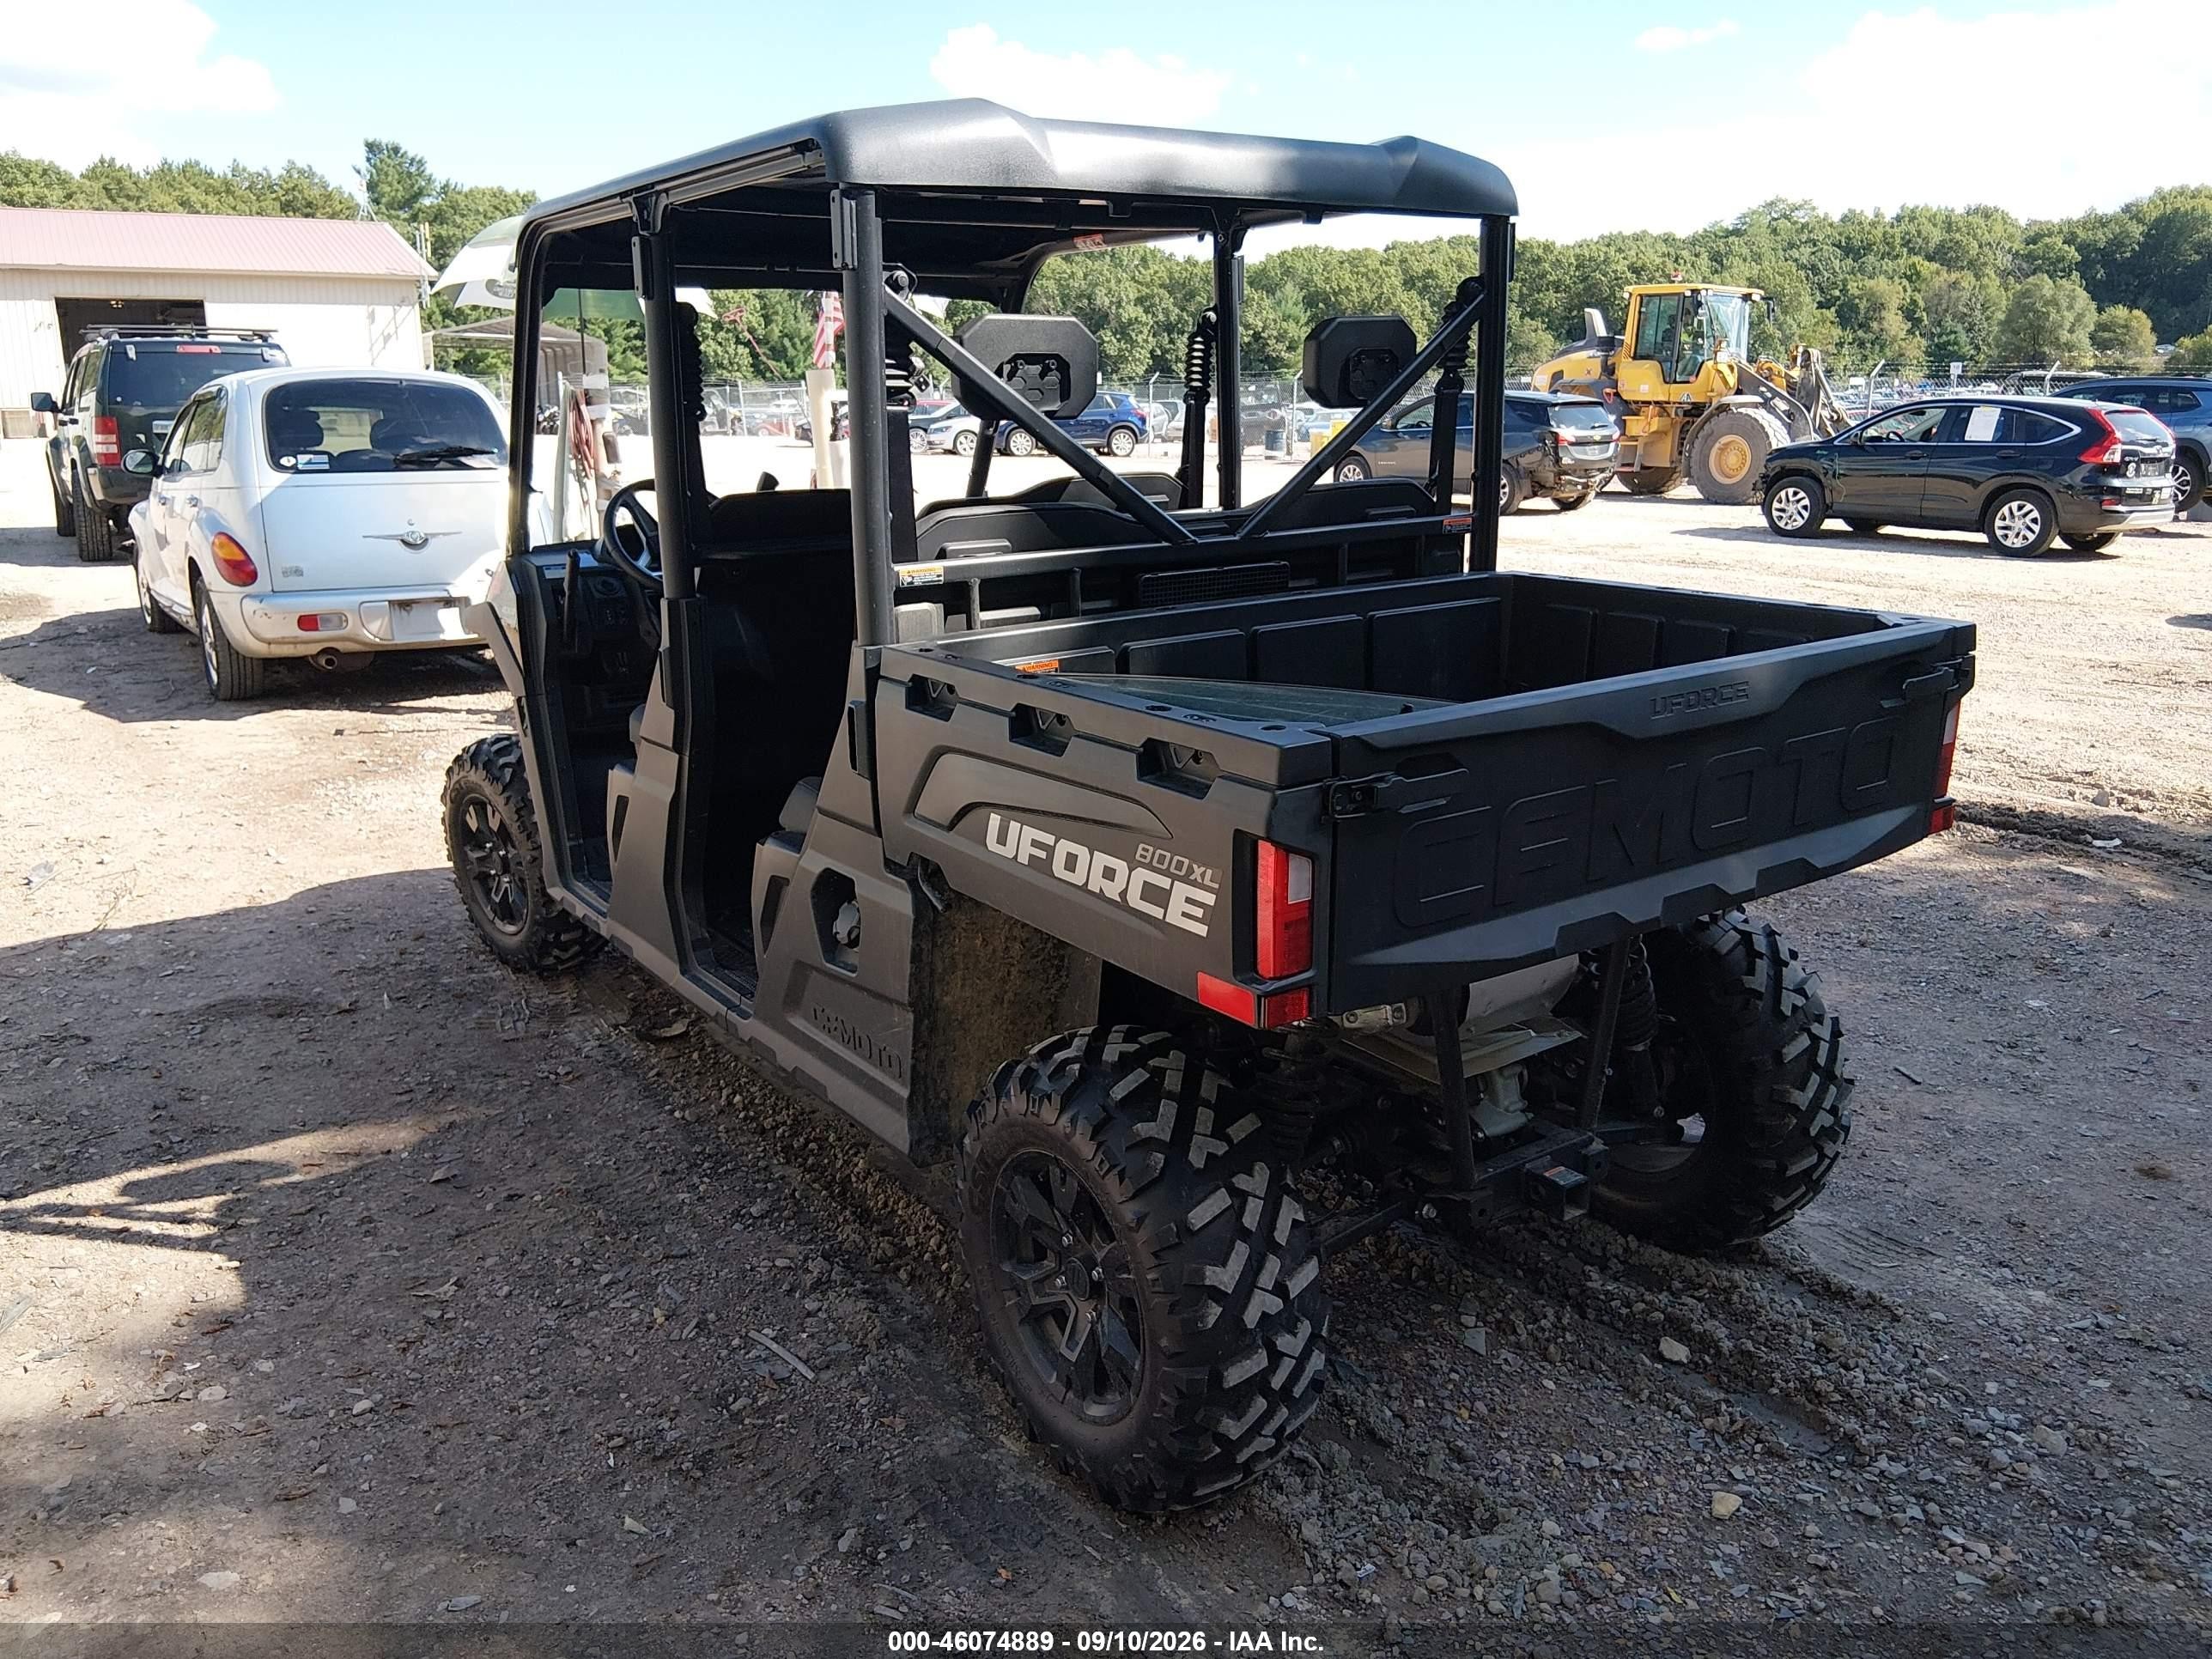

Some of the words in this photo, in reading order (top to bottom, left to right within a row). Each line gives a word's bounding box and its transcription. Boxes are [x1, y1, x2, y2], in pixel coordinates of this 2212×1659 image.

[1025, 662, 1053, 672] WARNING
[1650, 680, 1751, 720] UFORCE
[985, 812, 1217, 938] UFORCE
[1135, 842, 1220, 889] 800XL
